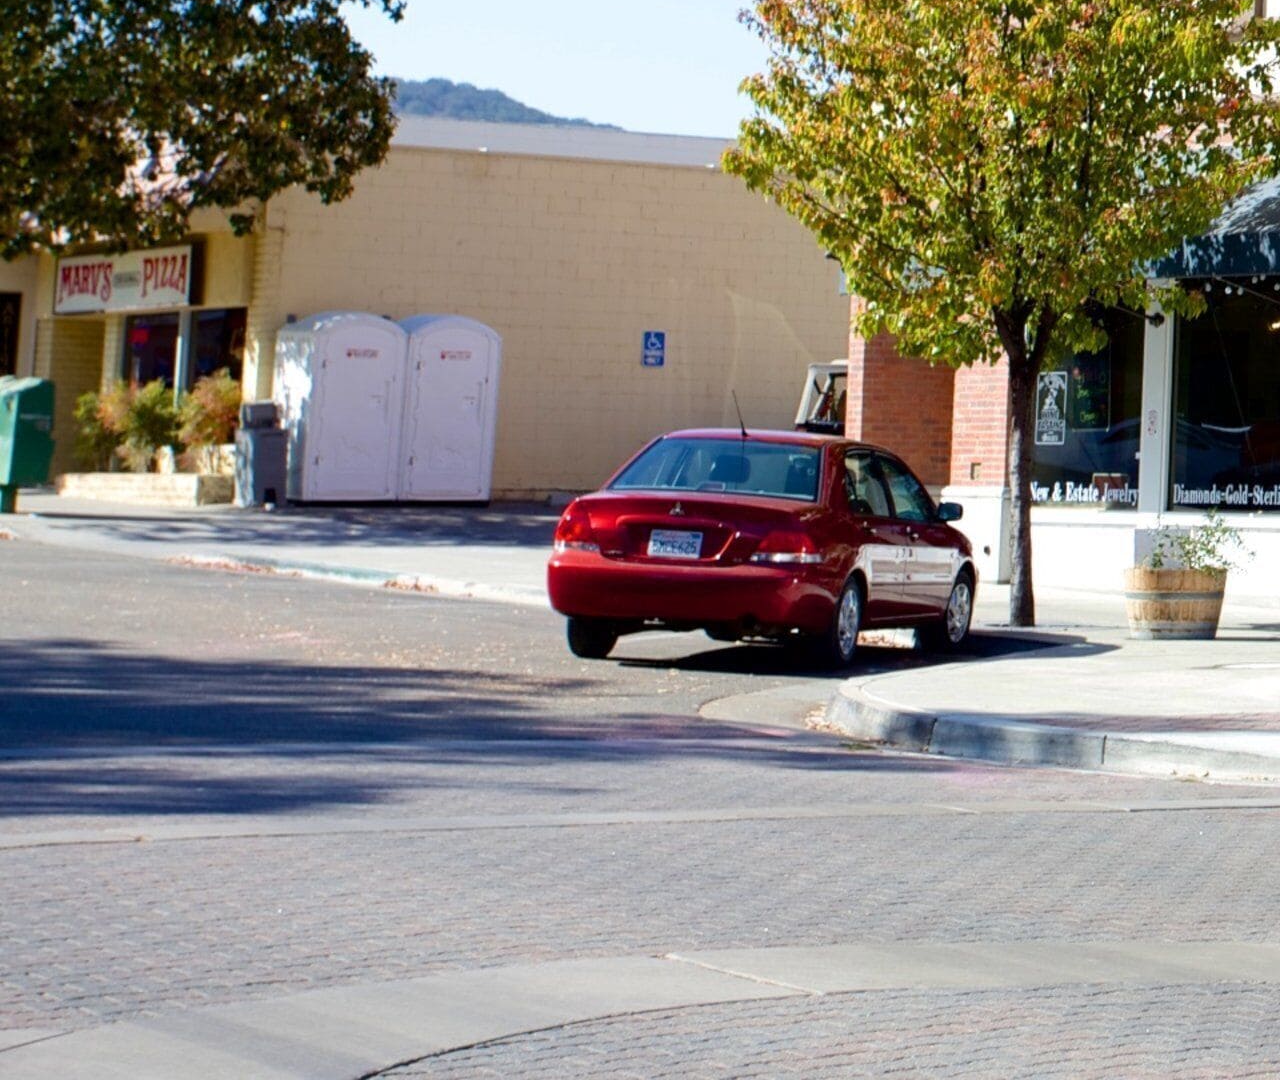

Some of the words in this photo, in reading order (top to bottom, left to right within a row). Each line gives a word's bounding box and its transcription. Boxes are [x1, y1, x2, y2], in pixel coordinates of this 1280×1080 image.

[140, 253, 189, 299] PIZZA
[1030, 481, 1050, 502] New
[1052, 481, 1063, 502] &
[1065, 481, 1099, 502] Estate
[1101, 482, 1139, 506] Jewelry
